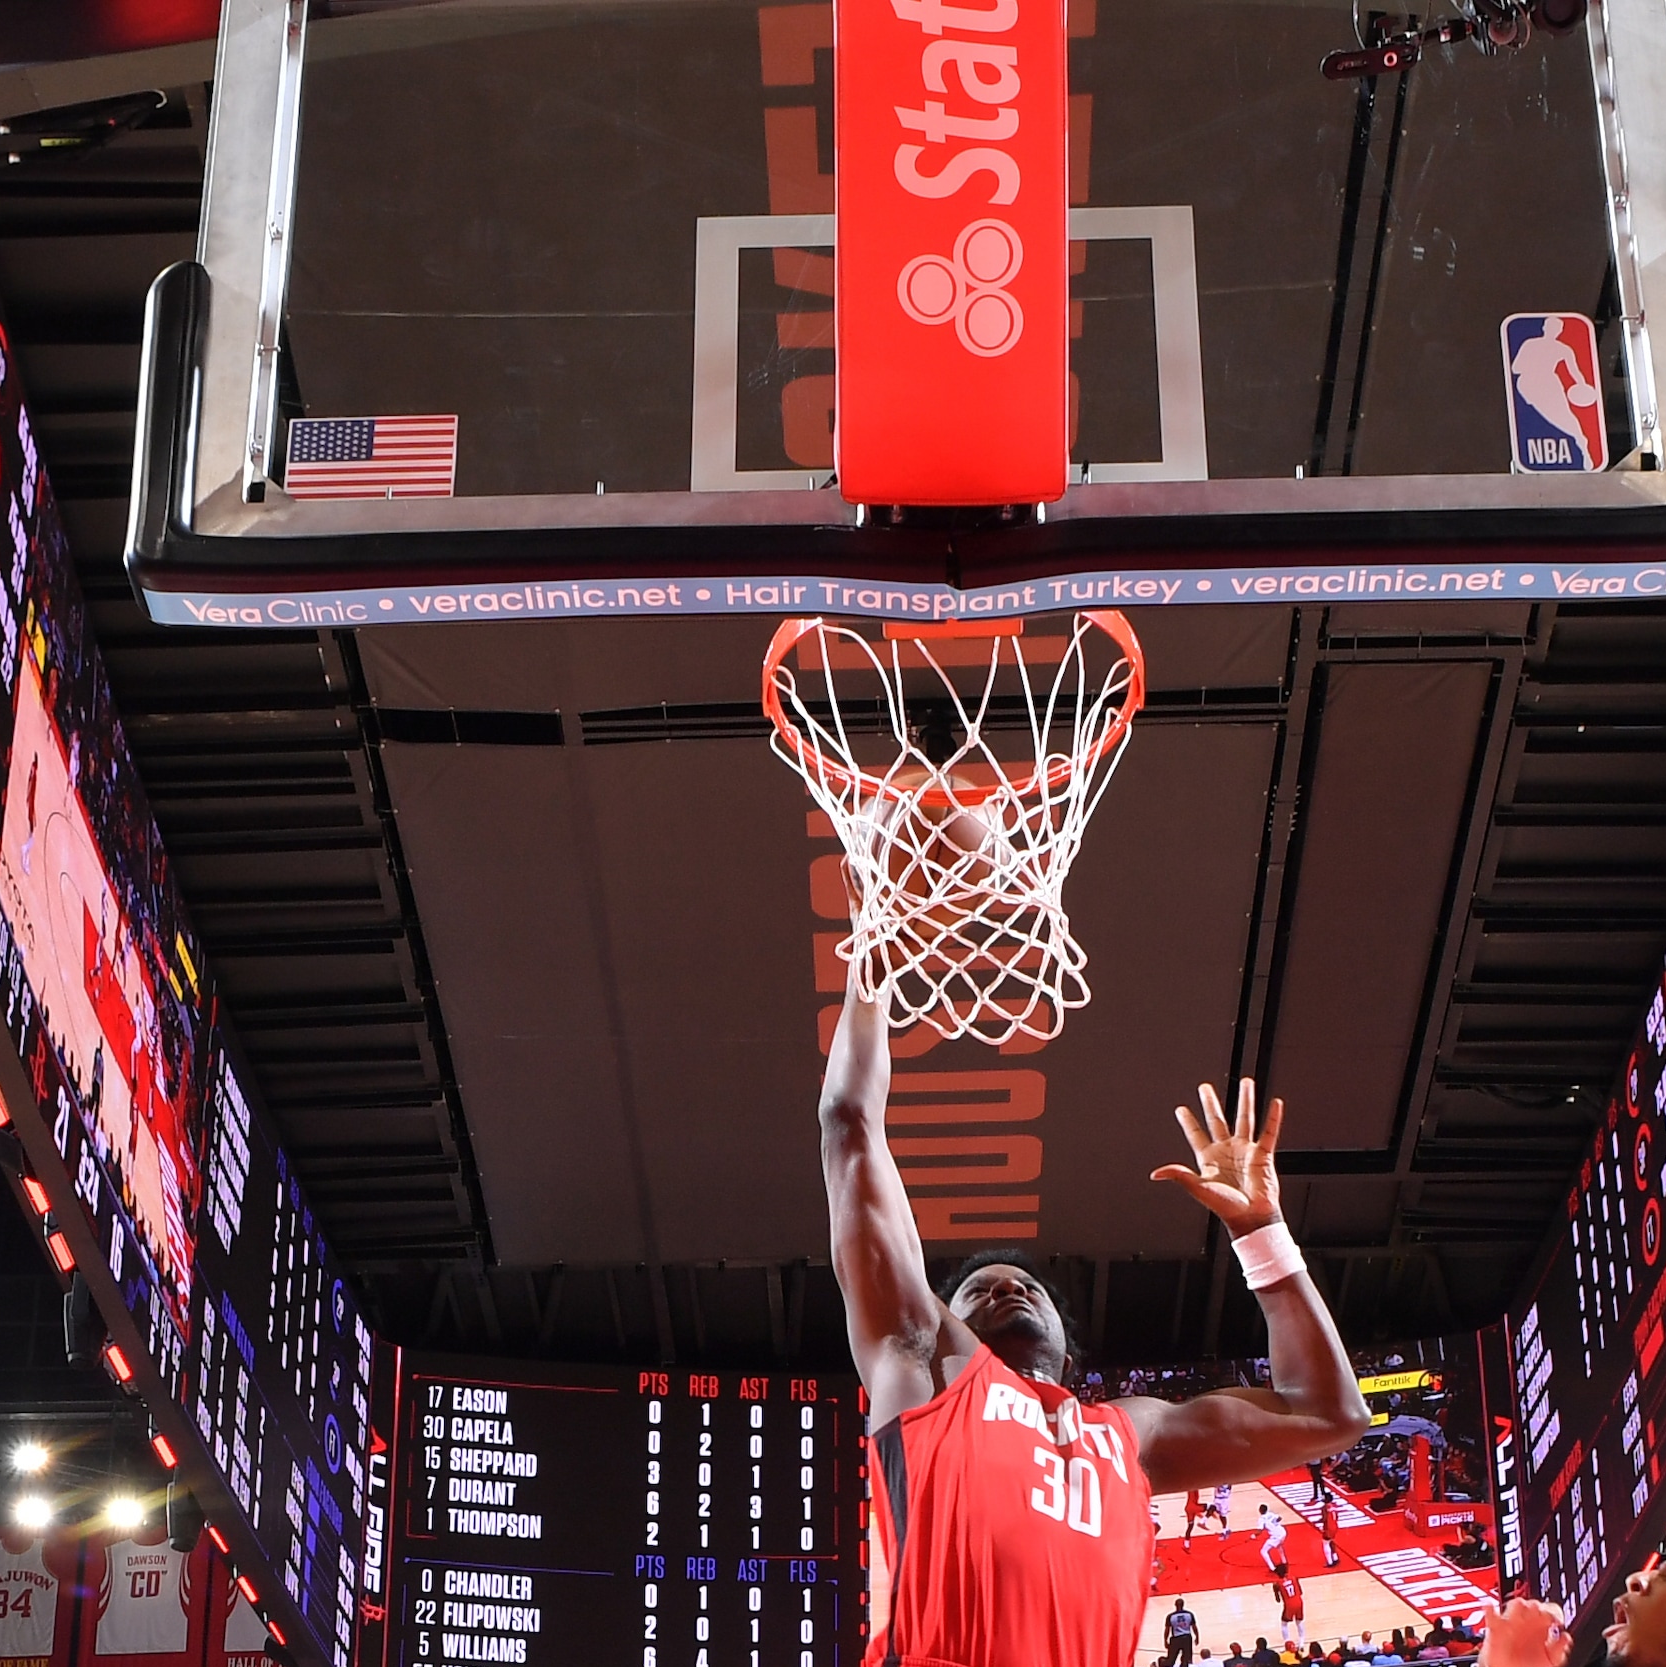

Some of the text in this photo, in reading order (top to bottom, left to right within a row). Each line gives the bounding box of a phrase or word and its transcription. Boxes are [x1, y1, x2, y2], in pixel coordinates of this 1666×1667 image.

[1524, 433, 1576, 469] NBA
[183, 598, 260, 624] Vera
[267, 598, 367, 623] Clinic
[408, 582, 682, 613] veraclinic.net
[724, 577, 809, 610] Hair
[817, 580, 1037, 623] Transplant
[1048, 576, 1182, 608] Turkey
[1230, 567, 1505, 597] veraclinic.net
[1550, 569, 1625, 595] Vera
[53, 1084, 71, 1160] 21
[78, 1137, 100, 1216] 3:24
[109, 1212, 125, 1282] 16
[639, 1373, 816, 1401] PTS REB AST FLS
[1372, 1373, 1411, 1390] Fanttik
[429, 1386, 507, 1414] 17 EASON
[424, 1416, 513, 1445] 30 CAPELA
[425, 1446, 537, 1477] 15 SHEPPARD
[427, 1476, 516, 1506] 7 DURANT
[1029, 1445, 1103, 1539] 30
[427, 1508, 541, 1538] 1 THOMPSON
[1499, 1491, 1524, 1577] FIRE
[126, 1553, 168, 1567] DAWSON
[363, 1501, 384, 1594] FIRE
[124, 1569, 169, 1598] "CD"
[636, 1555, 816, 1582] PTS REB AST FLS
[422, 1569, 532, 1600] 0 CHANDLER
[415, 1600, 540, 1634] 22 FILIPOWSKI
[419, 1632, 526, 1663] 5 WILLIAMS
